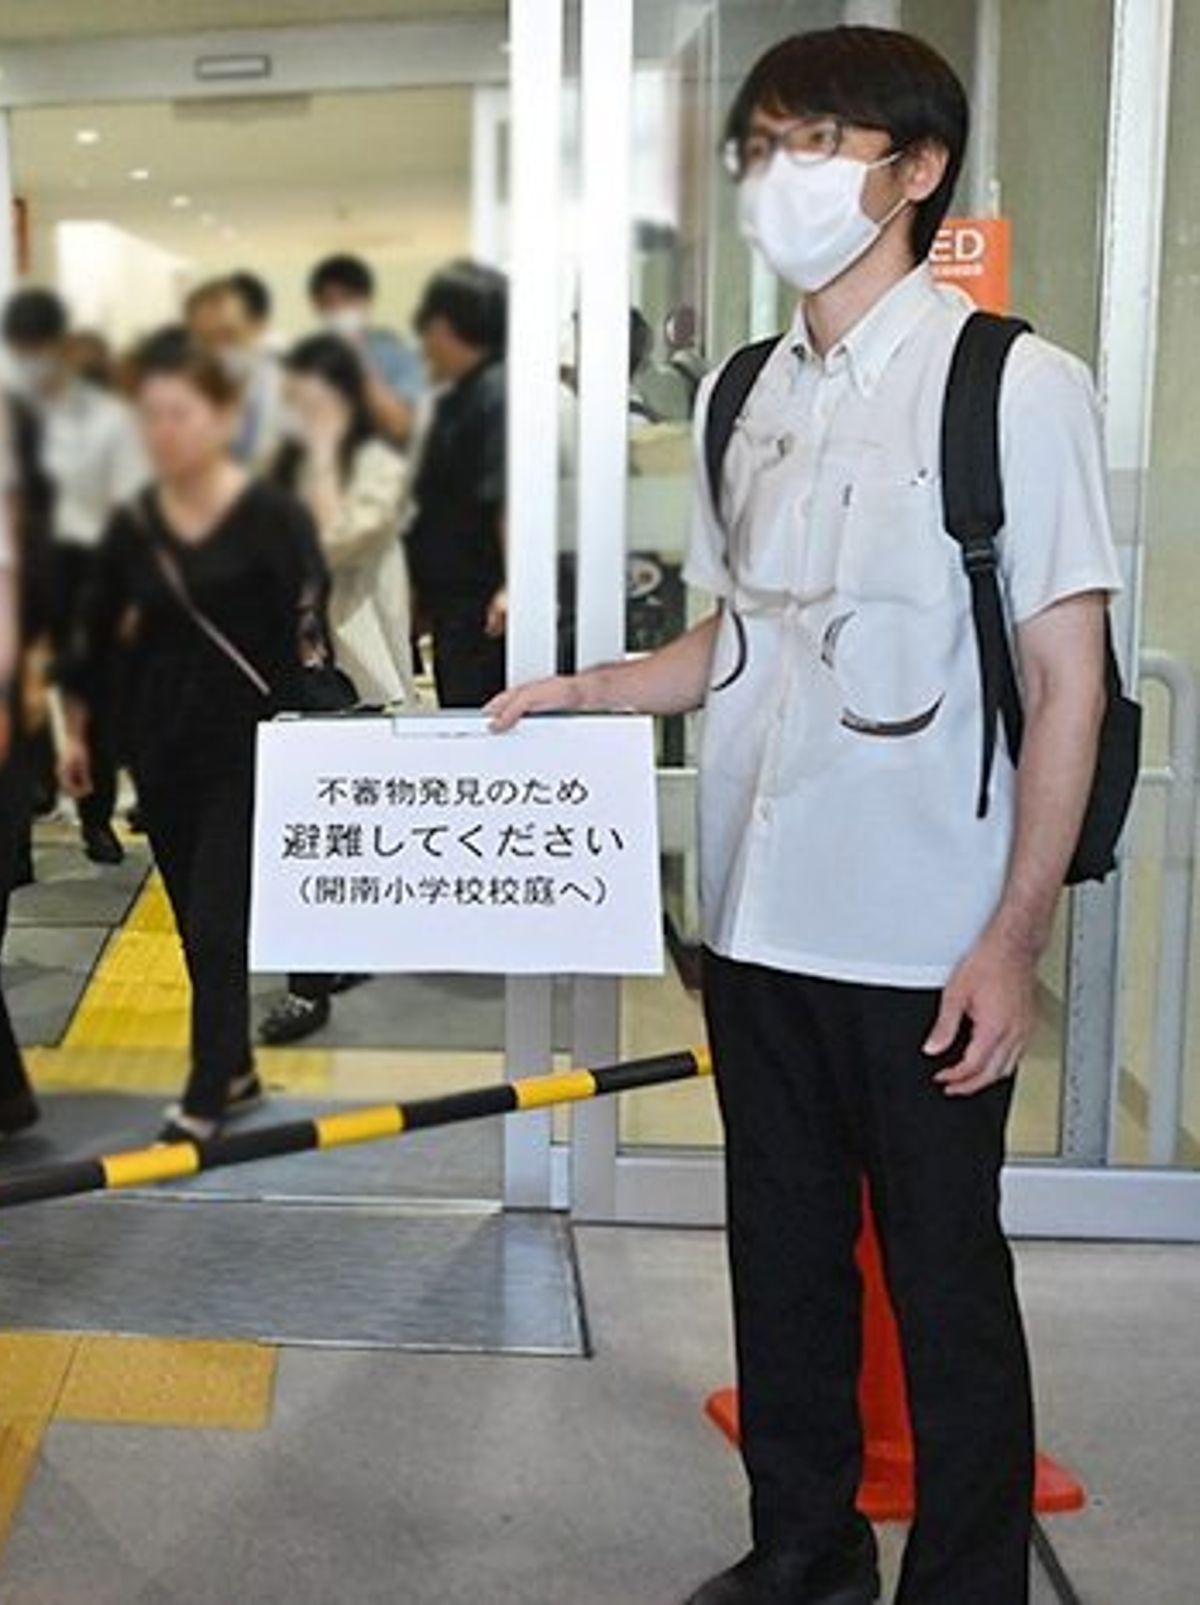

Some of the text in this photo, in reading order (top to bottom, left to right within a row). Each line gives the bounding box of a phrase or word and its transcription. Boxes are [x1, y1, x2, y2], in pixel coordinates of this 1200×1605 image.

[928, 229, 985, 261] ED
[319, 778, 588, 806] 不審物発見のため
[282, 823, 623, 859] 避難してください
[300, 876, 605, 904] （開南小学校校庭へ）
